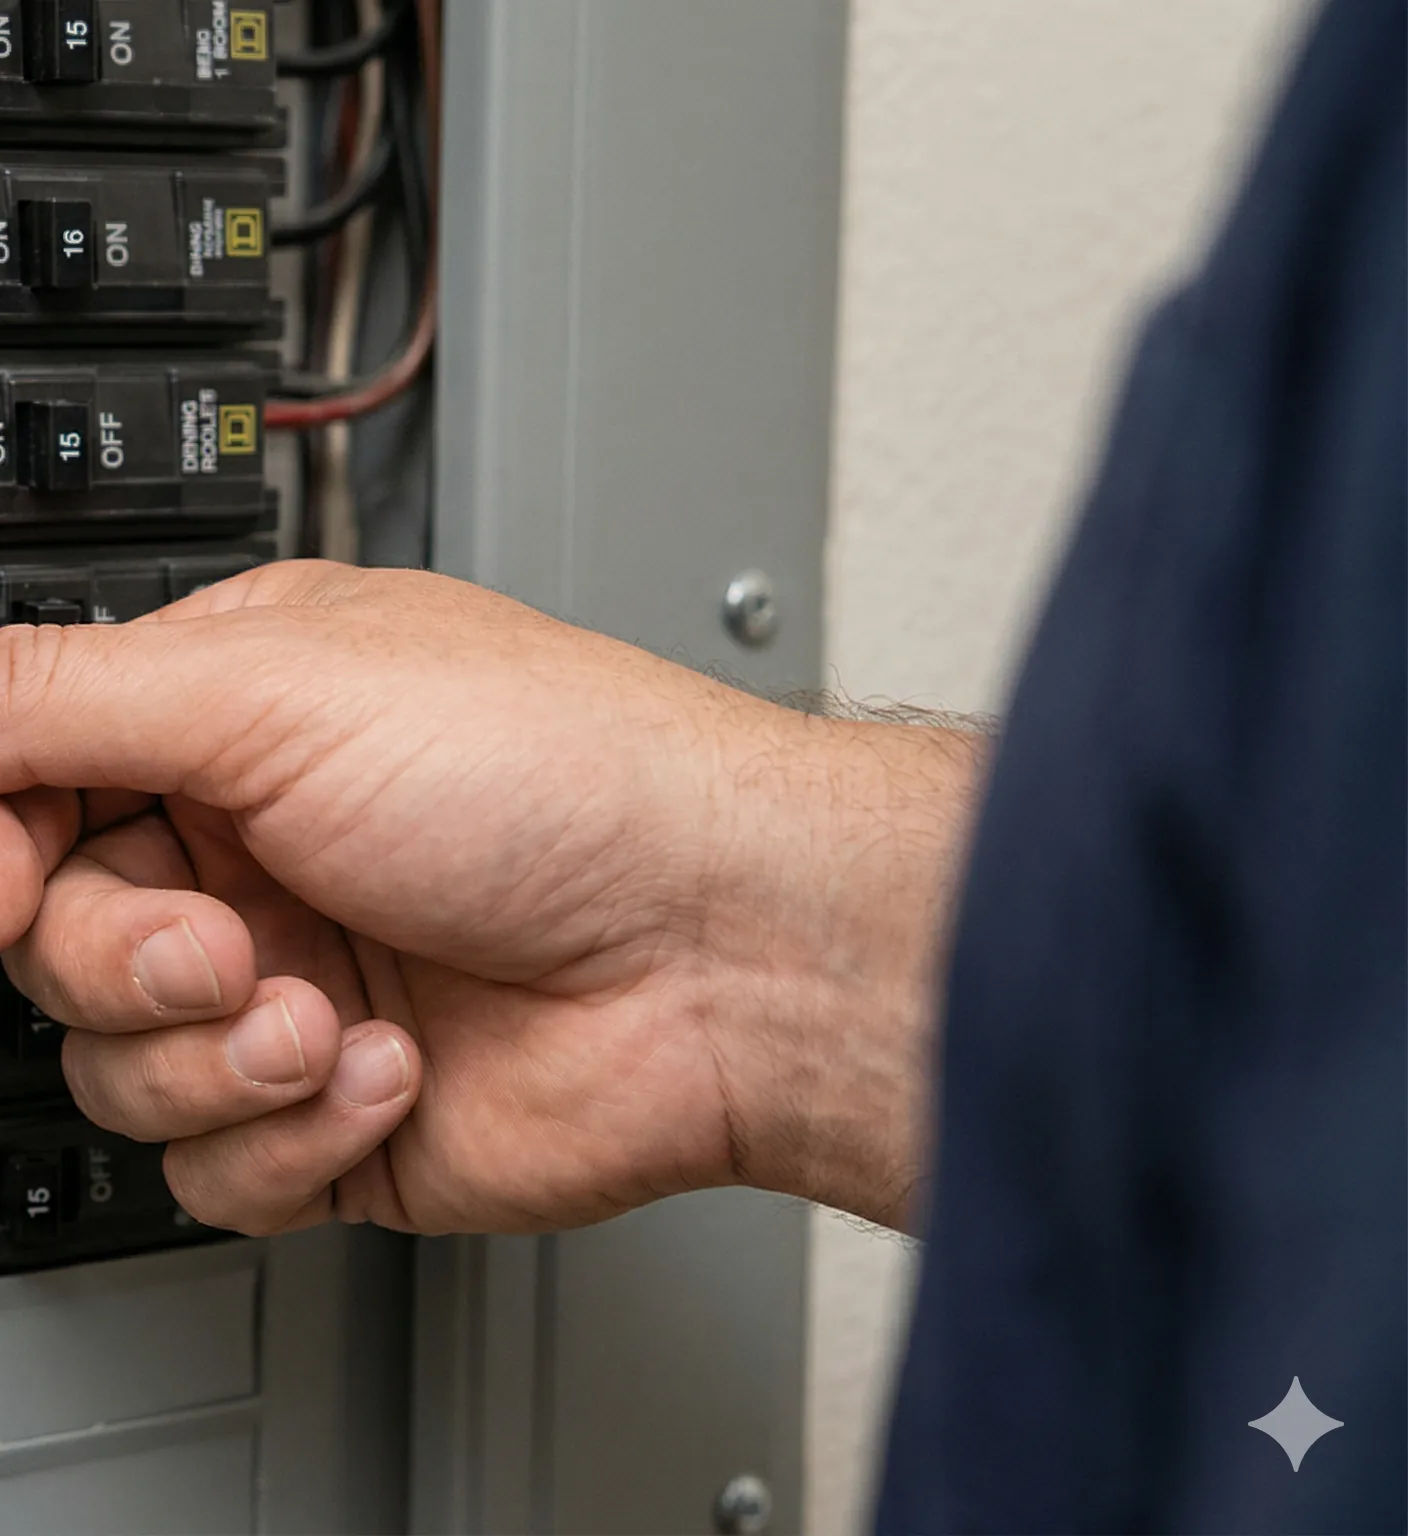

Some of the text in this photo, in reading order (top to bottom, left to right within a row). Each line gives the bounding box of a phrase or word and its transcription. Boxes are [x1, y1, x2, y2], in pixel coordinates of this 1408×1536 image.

[66, 21, 88, 50] 15
[109, 21, 133, 65] ON
[63, 229, 84, 258] 16
[105, 223, 129, 267] ON
[59, 432, 80, 461] 15
[99, 412, 123, 468] OFF
[89, 1147, 112, 1203] OFF
[27, 1187, 51, 1218] 15
